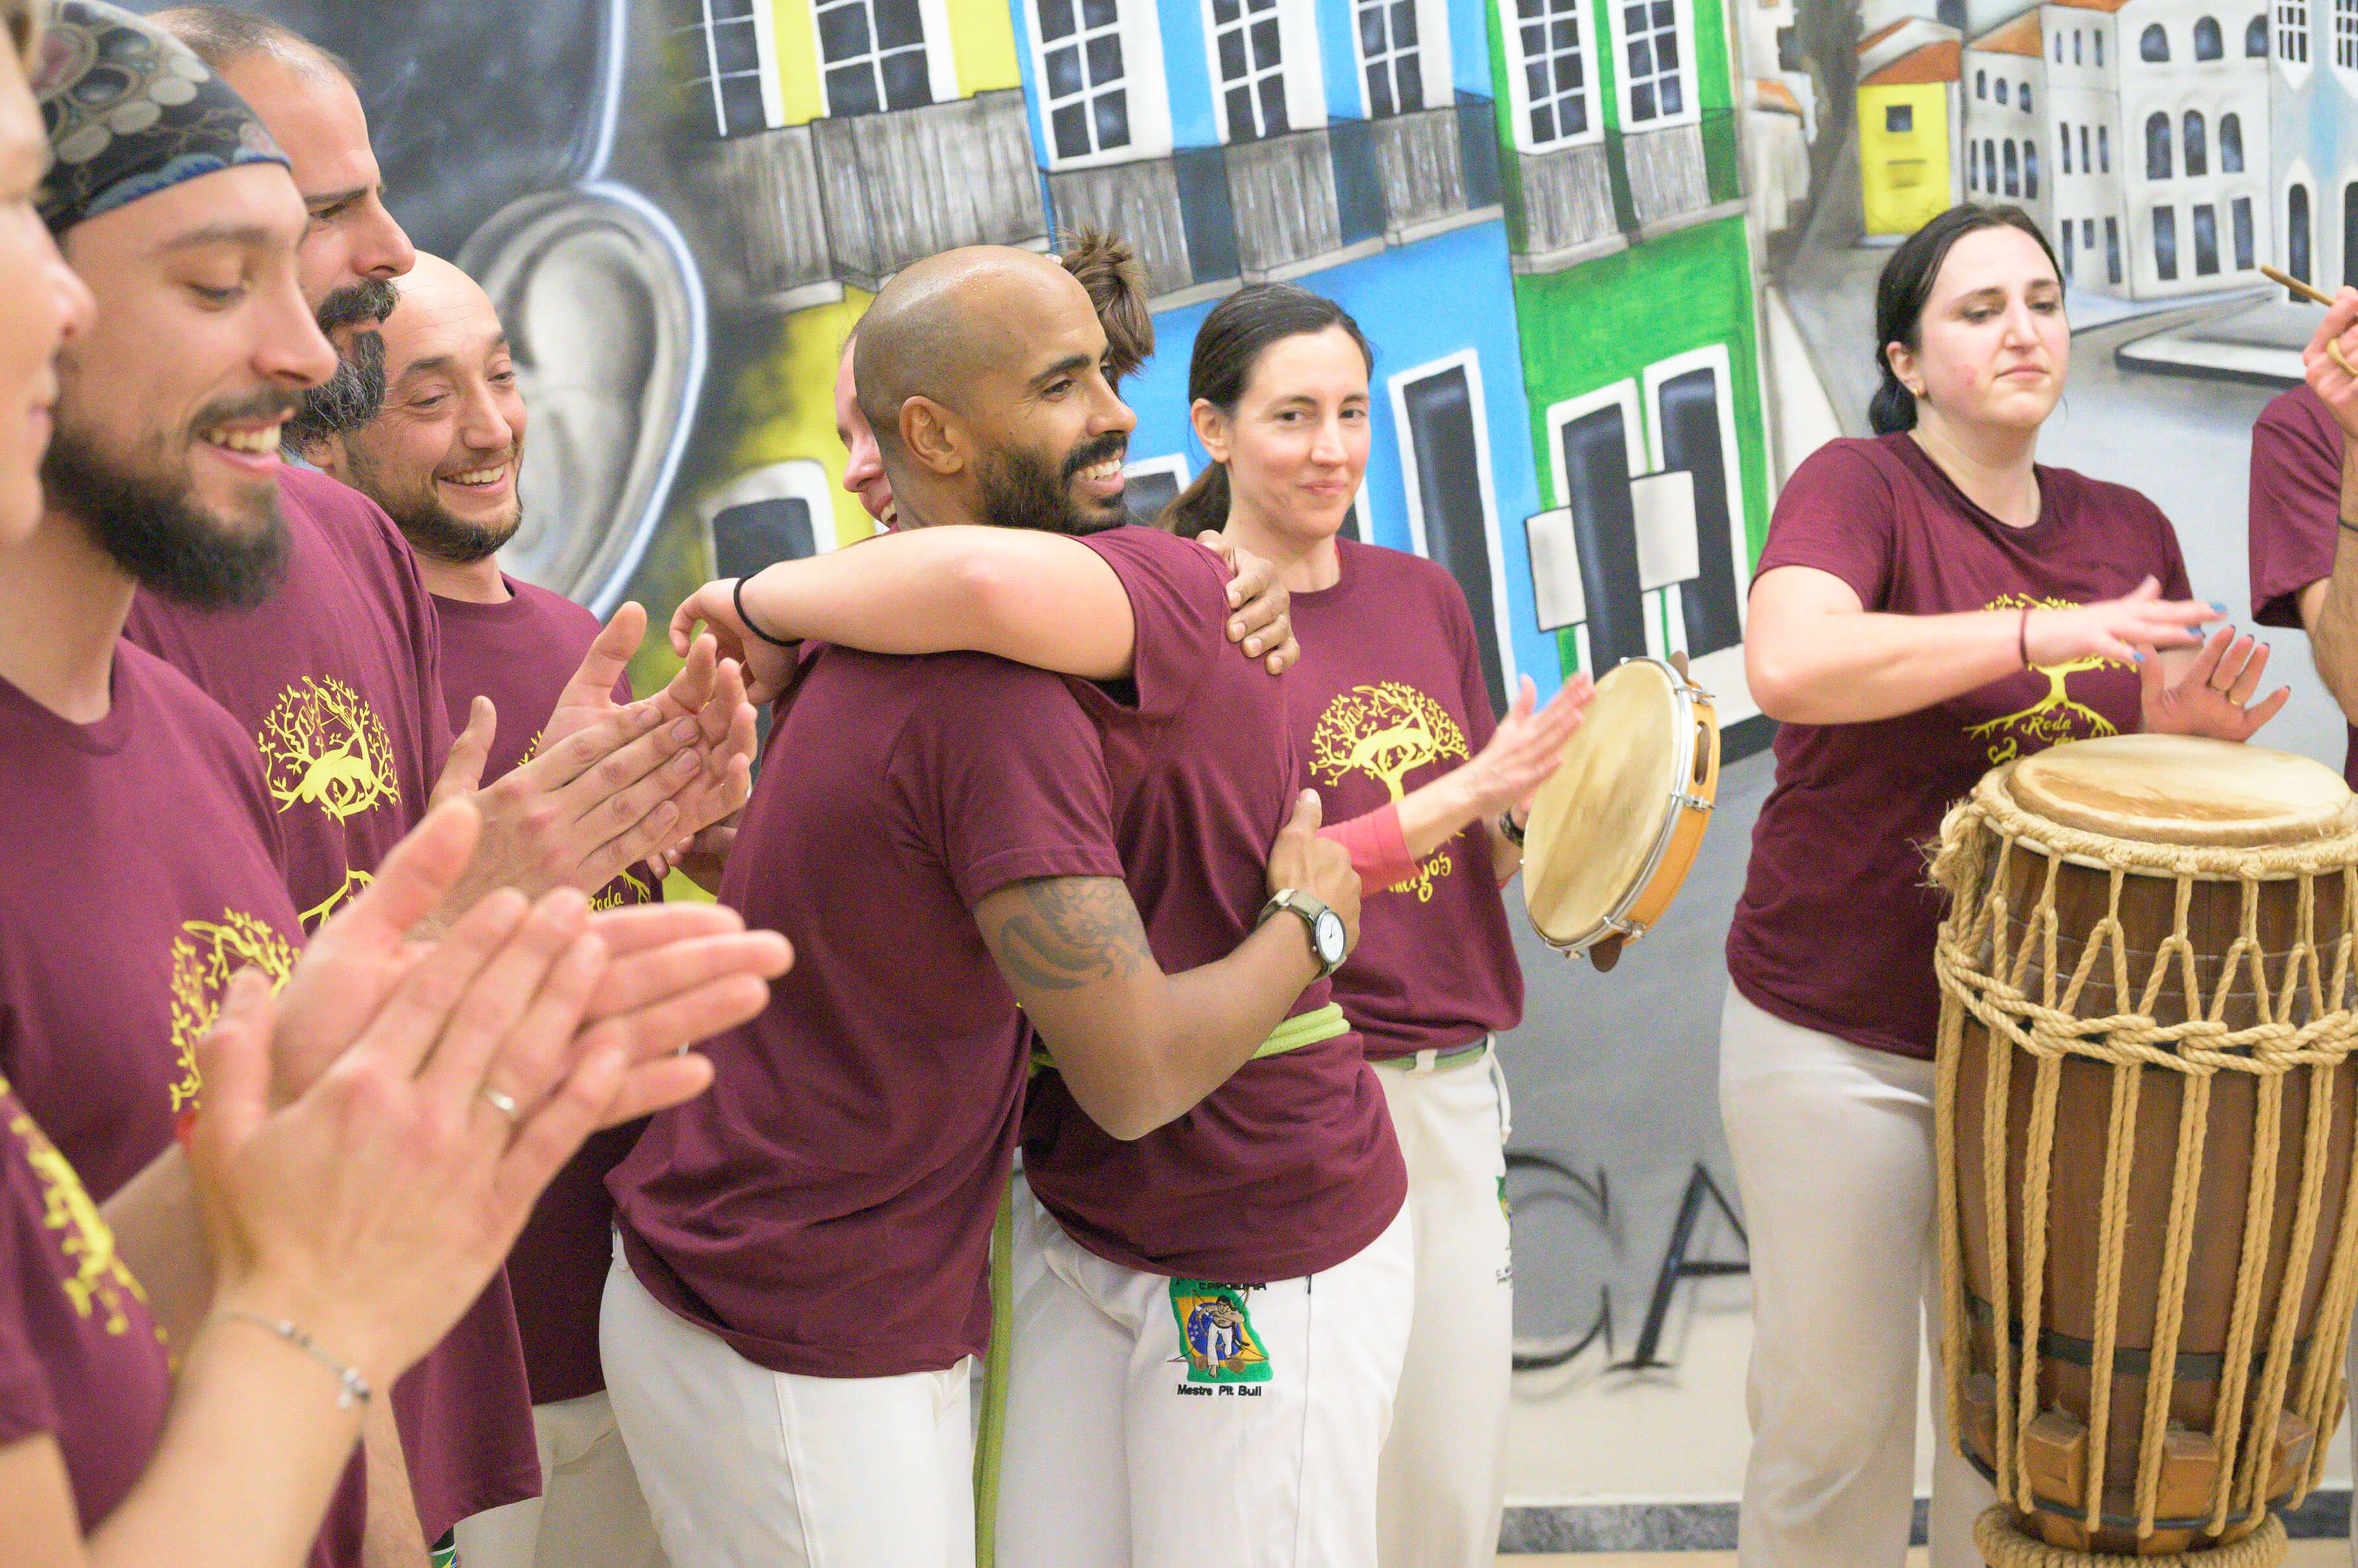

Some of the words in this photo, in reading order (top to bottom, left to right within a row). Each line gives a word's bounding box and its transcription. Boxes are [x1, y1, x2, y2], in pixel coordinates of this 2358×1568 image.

[2021, 712, 2072, 741] Roda
[1177, 1383, 1213, 1396] Mestre
[1219, 1385, 1234, 1396] Pit
[1238, 1385, 1262, 1396] Bull
